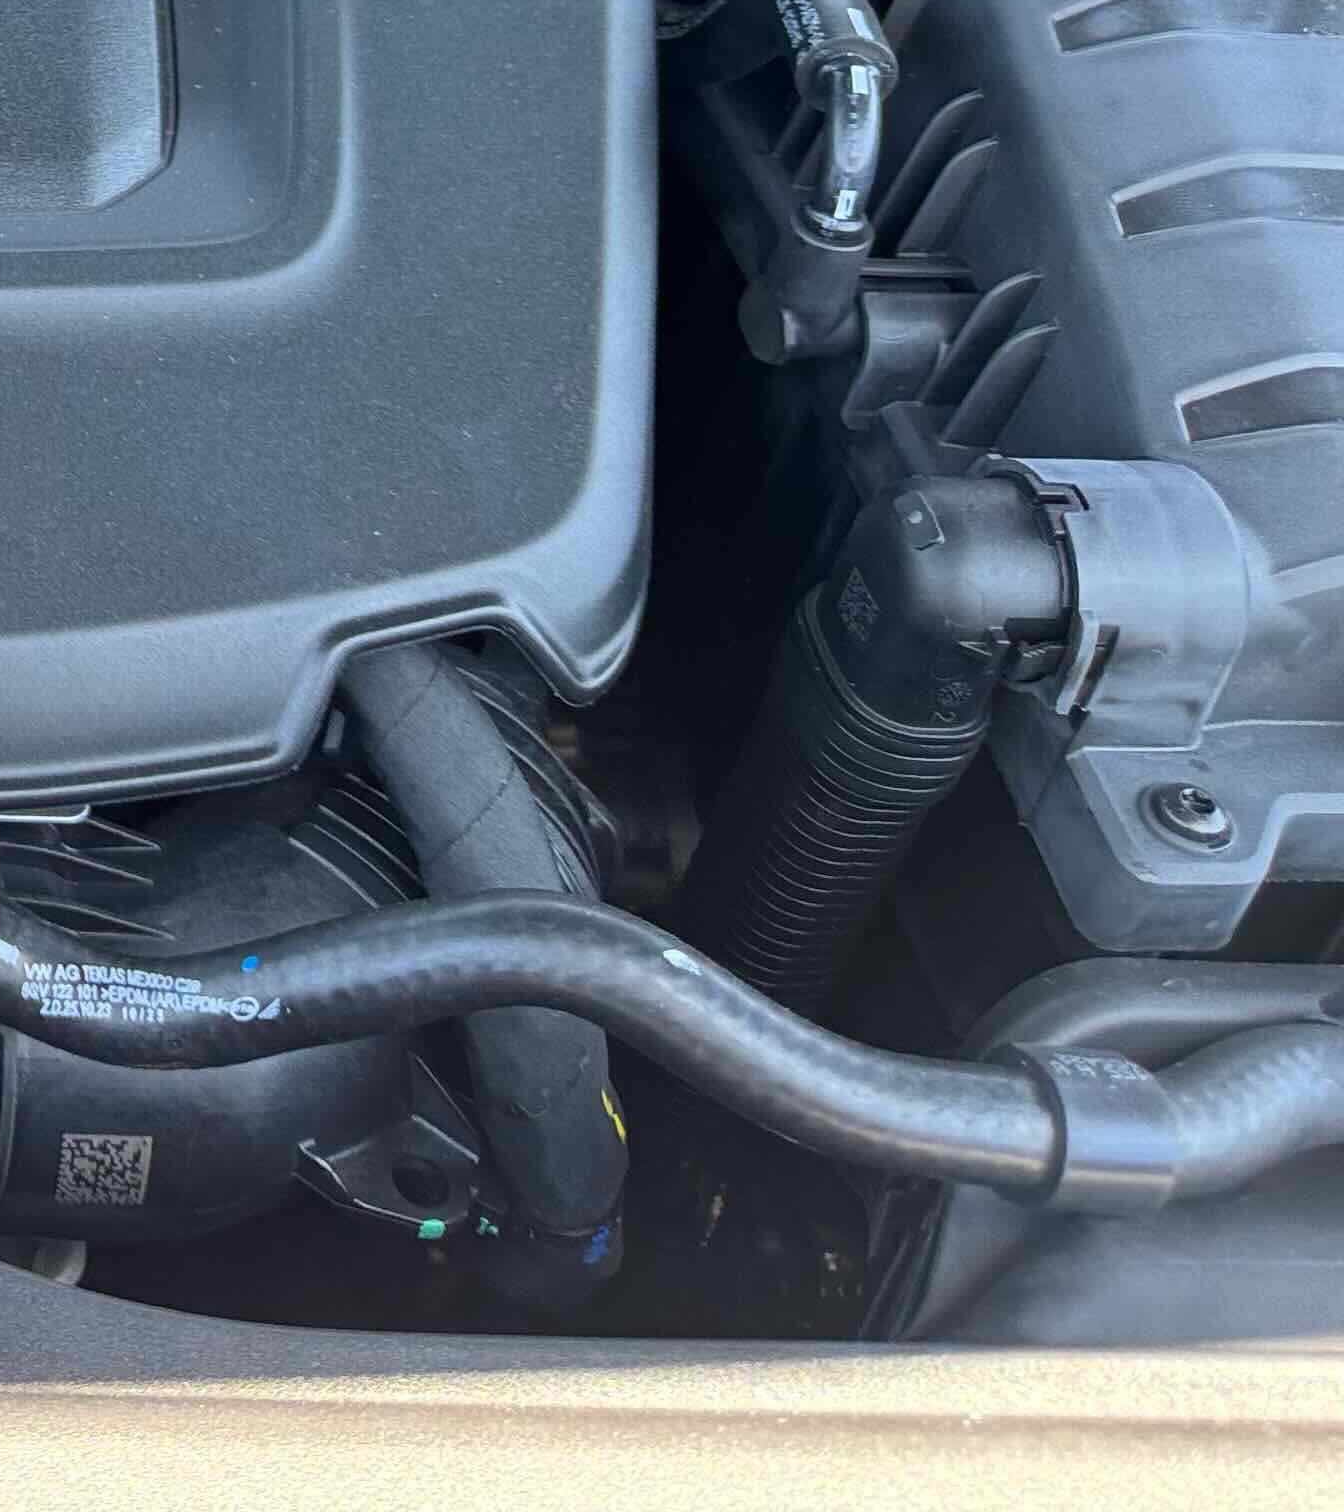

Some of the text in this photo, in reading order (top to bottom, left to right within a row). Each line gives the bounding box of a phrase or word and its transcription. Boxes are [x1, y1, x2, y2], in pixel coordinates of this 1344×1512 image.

[23, 961, 52, 981] VW
[54, 963, 81, 982] AG
[52, 983, 73, 999] 122
